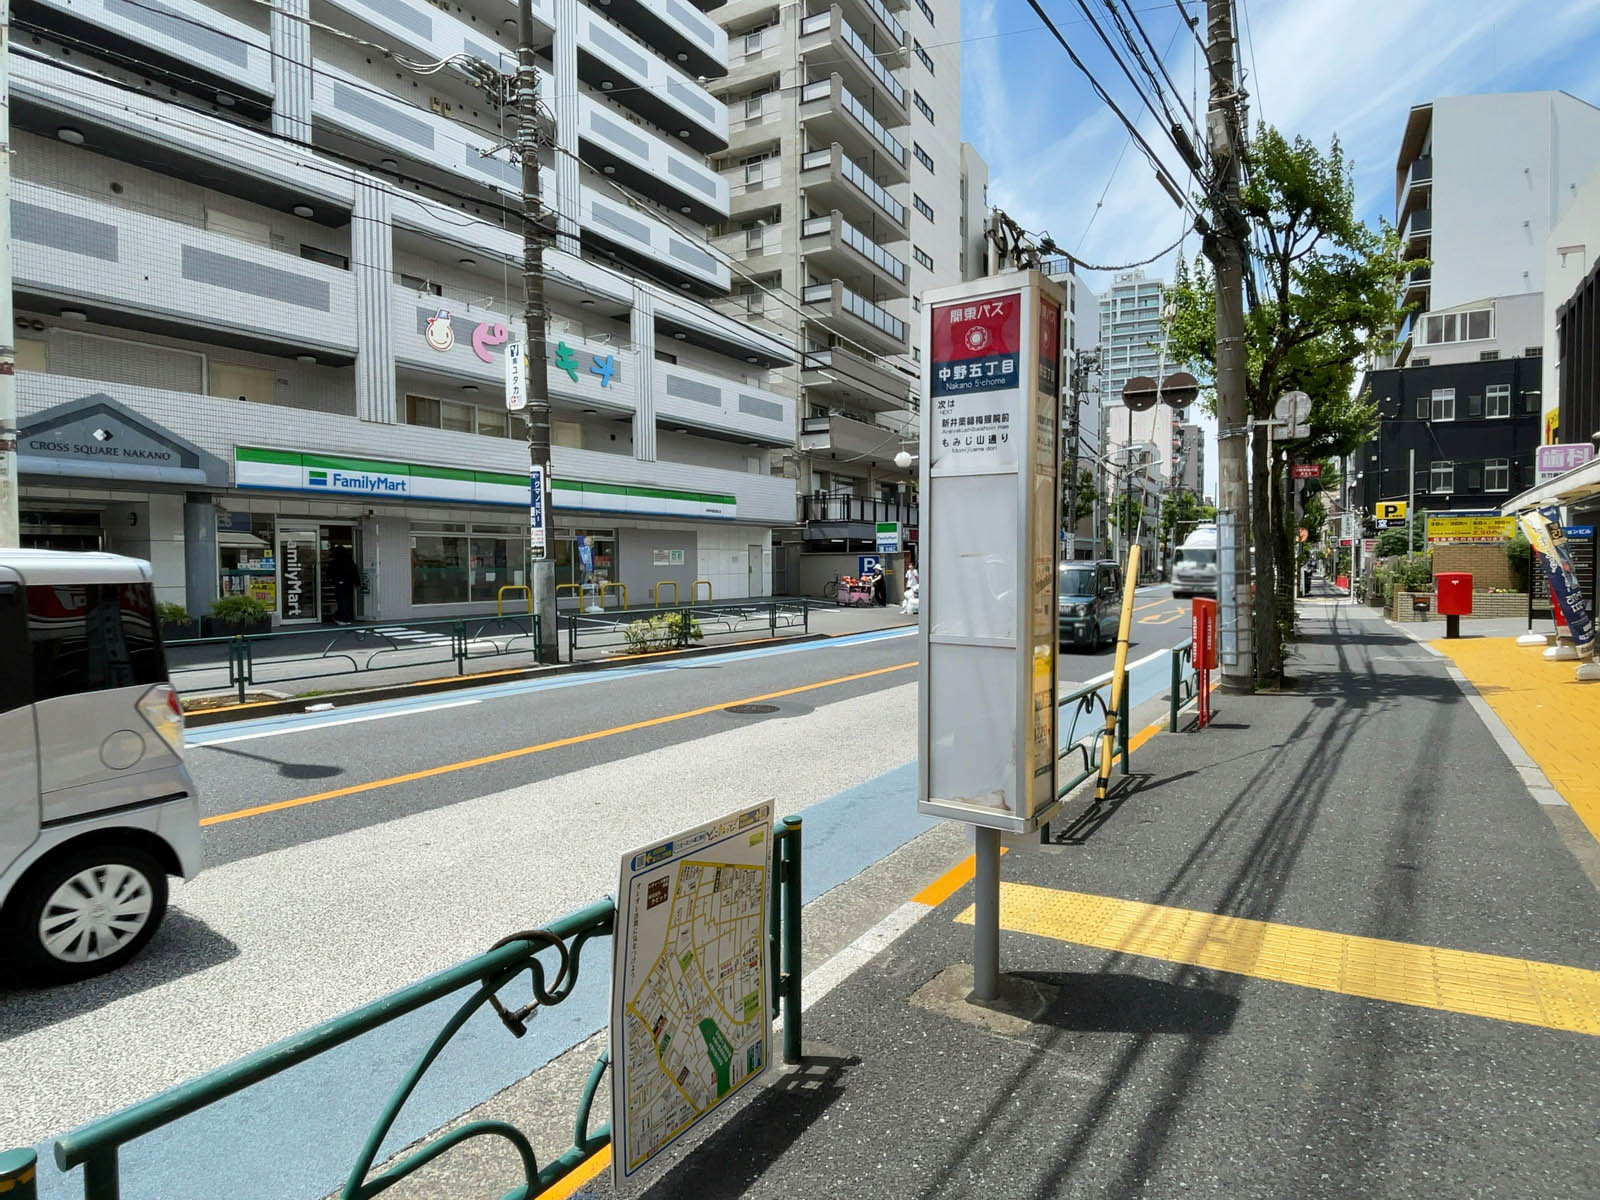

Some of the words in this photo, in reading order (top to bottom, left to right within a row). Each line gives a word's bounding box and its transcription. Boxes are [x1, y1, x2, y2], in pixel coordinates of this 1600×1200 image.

[950, 302, 1004, 323] 関東バス
[938, 359, 1014, 382] 中野五丁目
[945, 381, 973, 391] Nakano
[974, 378, 1006, 388] 5-chome
[937, 400, 955, 409] 次は
[941, 433, 1009, 448] もみじ山通り
[30, 440, 70, 453] CROSS
[73, 444, 119, 456] SQUARE
[123, 449, 171, 461] NAKANO
[1543, 447, 1590, 468] 歯科
[333, 473, 406, 491] FamilyMart
[1384, 505, 1398, 517] P
[863, 557, 876, 572] P
